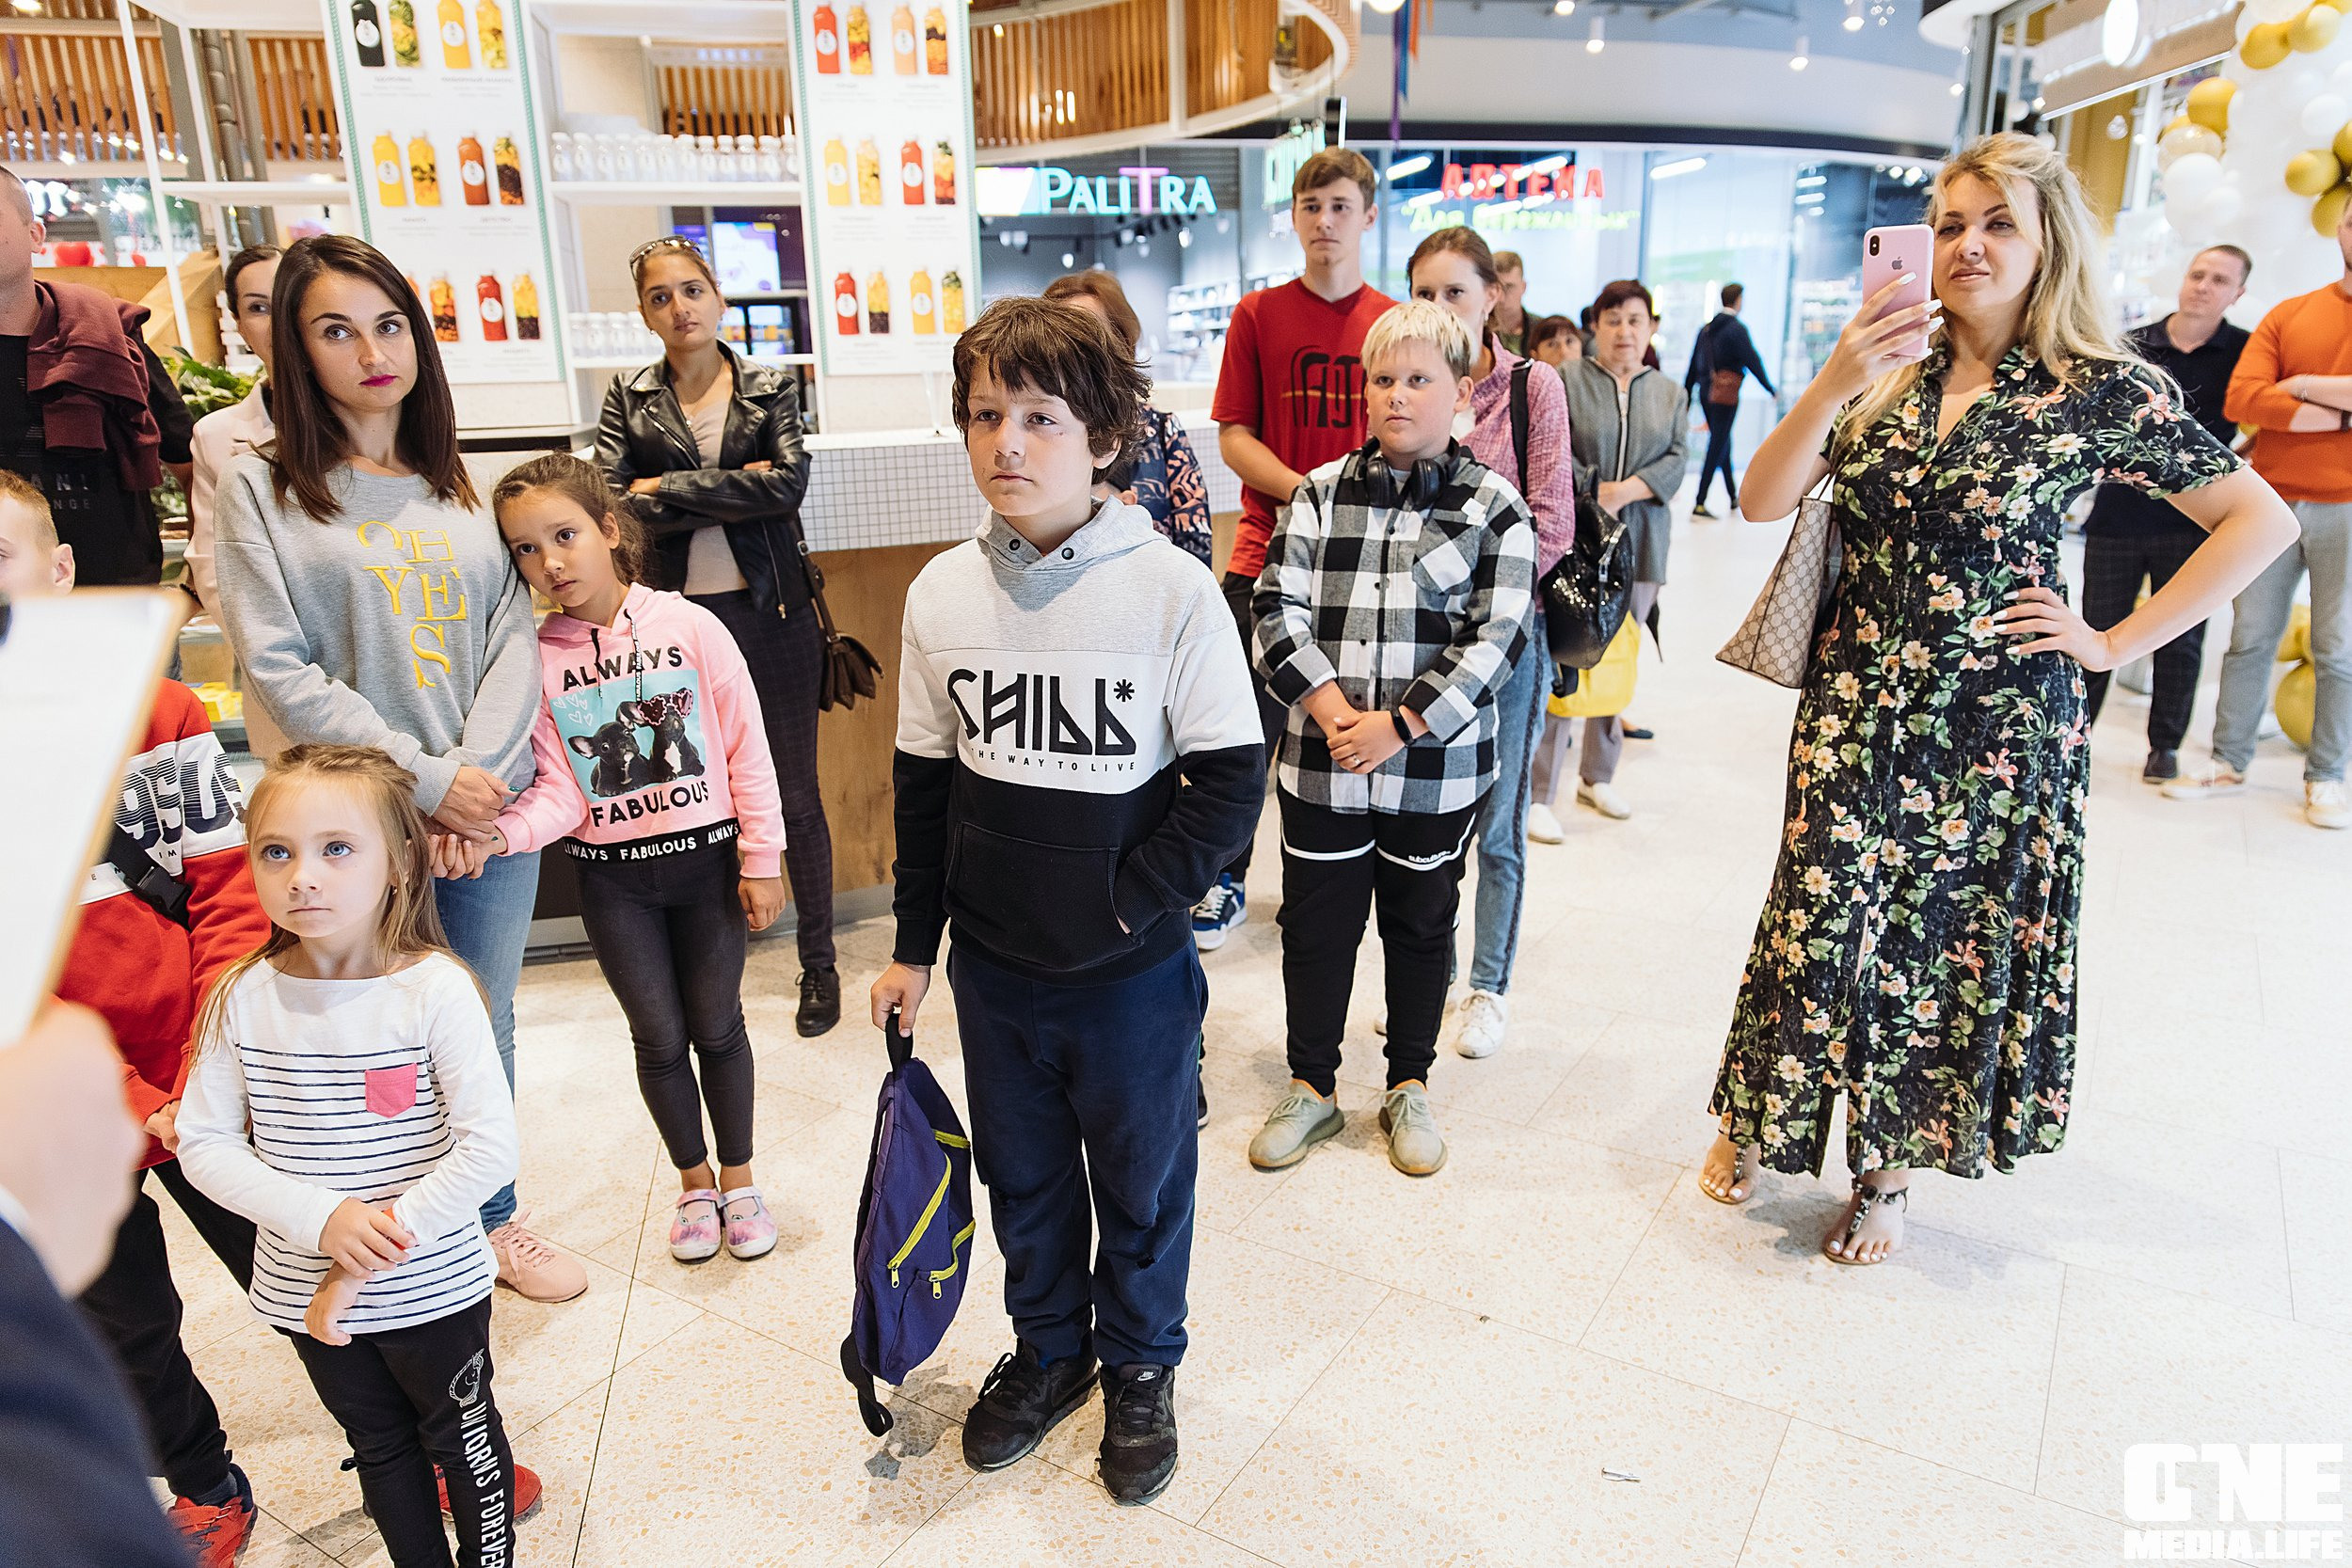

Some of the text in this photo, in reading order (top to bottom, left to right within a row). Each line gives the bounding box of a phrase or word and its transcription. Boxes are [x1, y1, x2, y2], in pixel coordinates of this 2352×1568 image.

[1039, 166, 1217, 215] PALITRA
[564, 646, 682, 691] ALWAYS
[1008, 754, 1044, 768] WAY
[1057, 761, 1078, 771] TO
[1090, 761, 1135, 772] LIVE
[590, 780, 709, 828] FABULOUS
[620, 836, 697, 861] FABULOUS
[707, 823, 739, 845] ALWAYS
[480, 1487, 507, 1568] FOREVER
